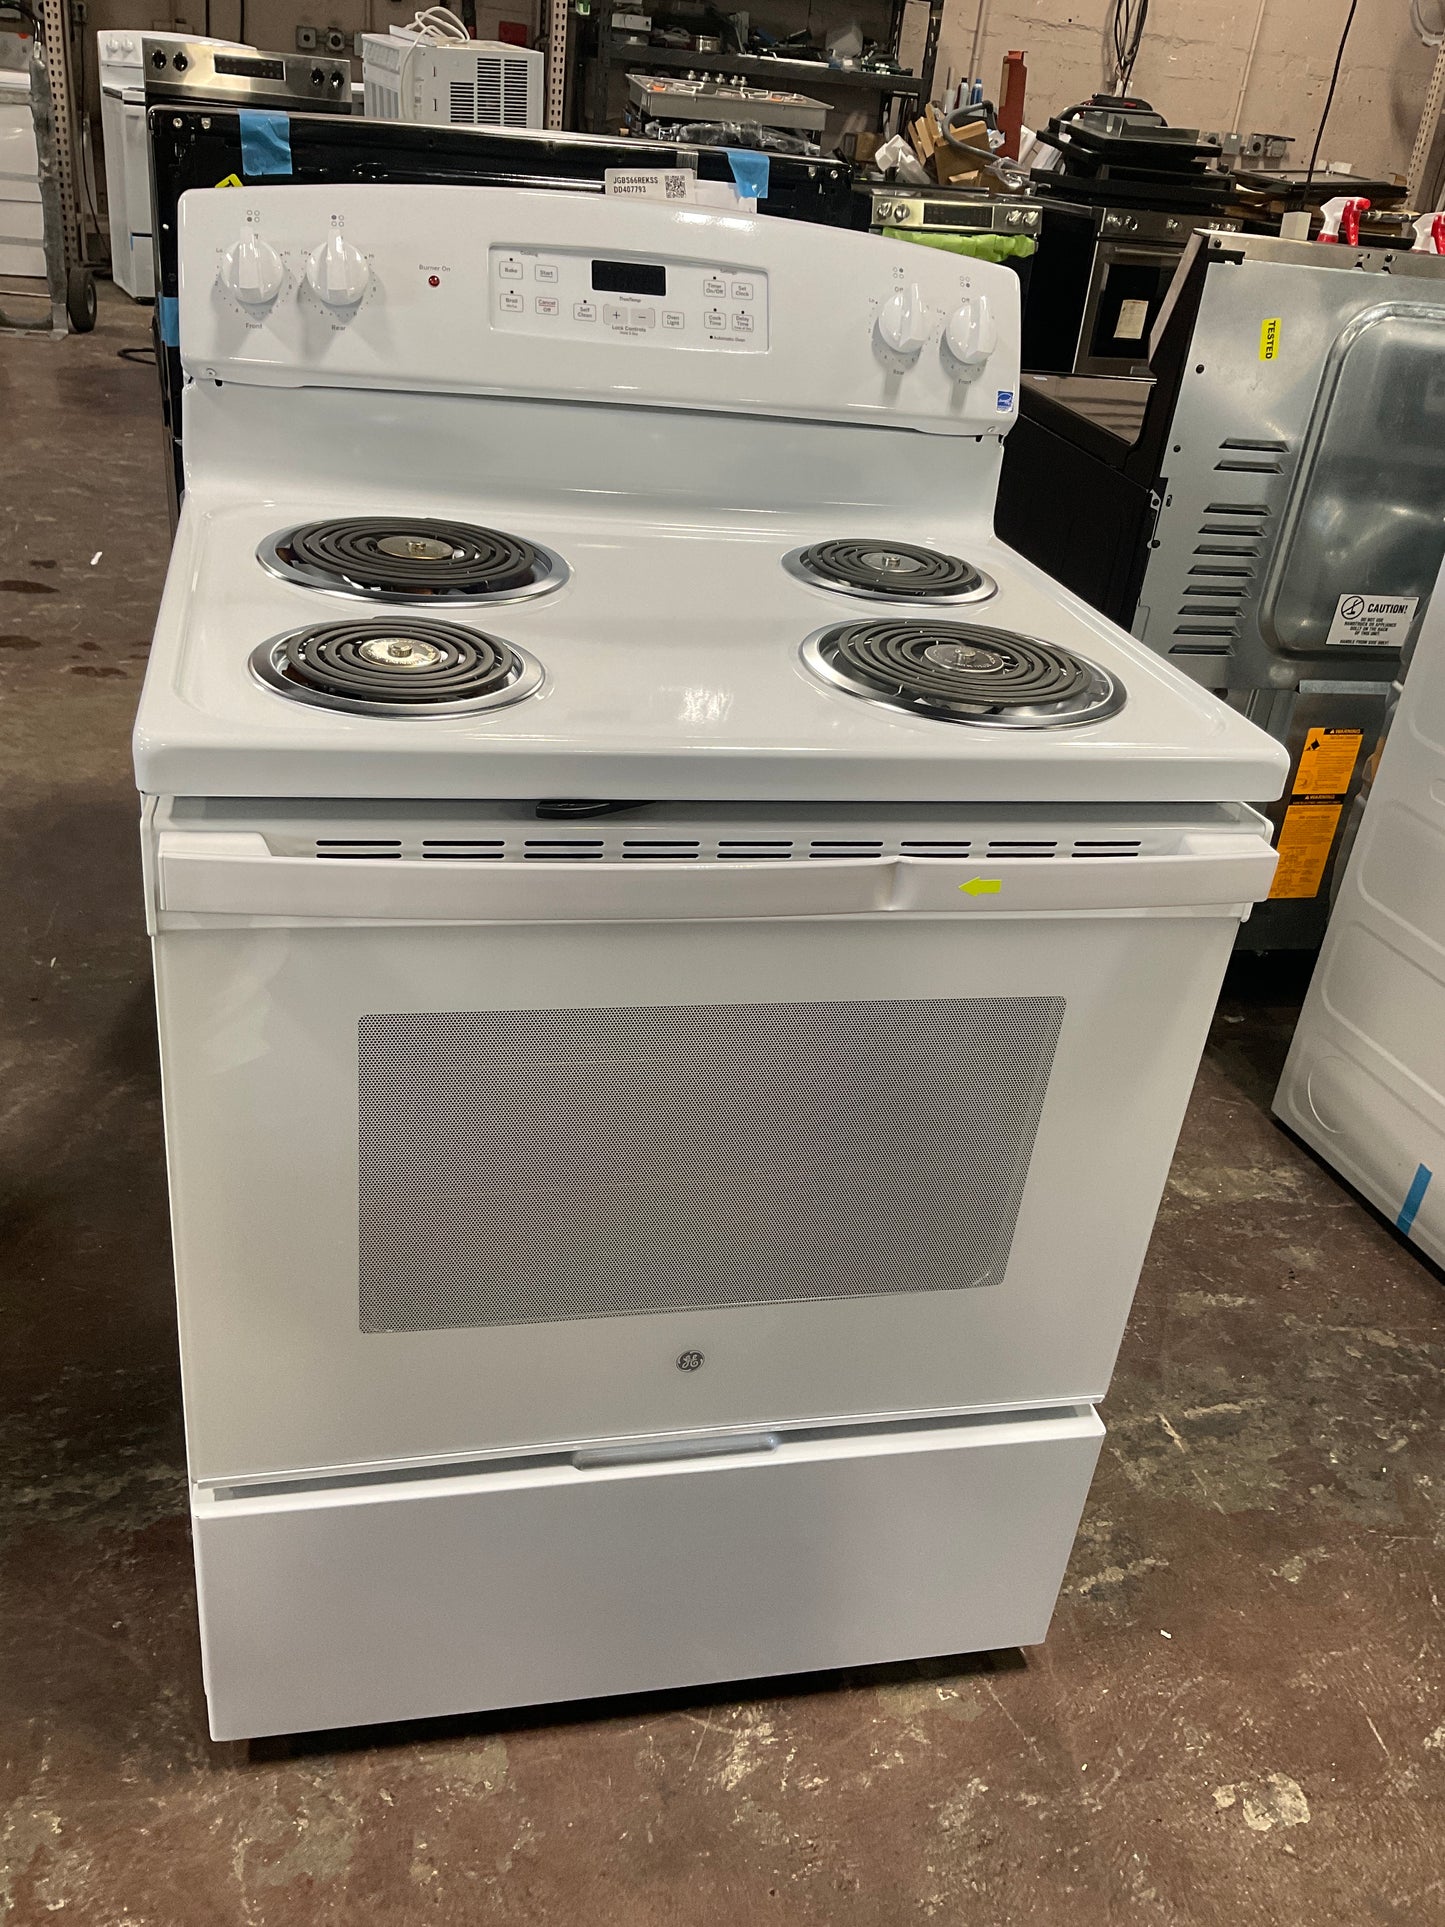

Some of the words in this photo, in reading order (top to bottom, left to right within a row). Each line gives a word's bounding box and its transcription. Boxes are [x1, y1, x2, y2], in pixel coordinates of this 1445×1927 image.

[613, 185, 646, 193] DD407793
[1265, 320, 1276, 359] TESTED
[1367, 603, 1408, 614] CAUTION!
